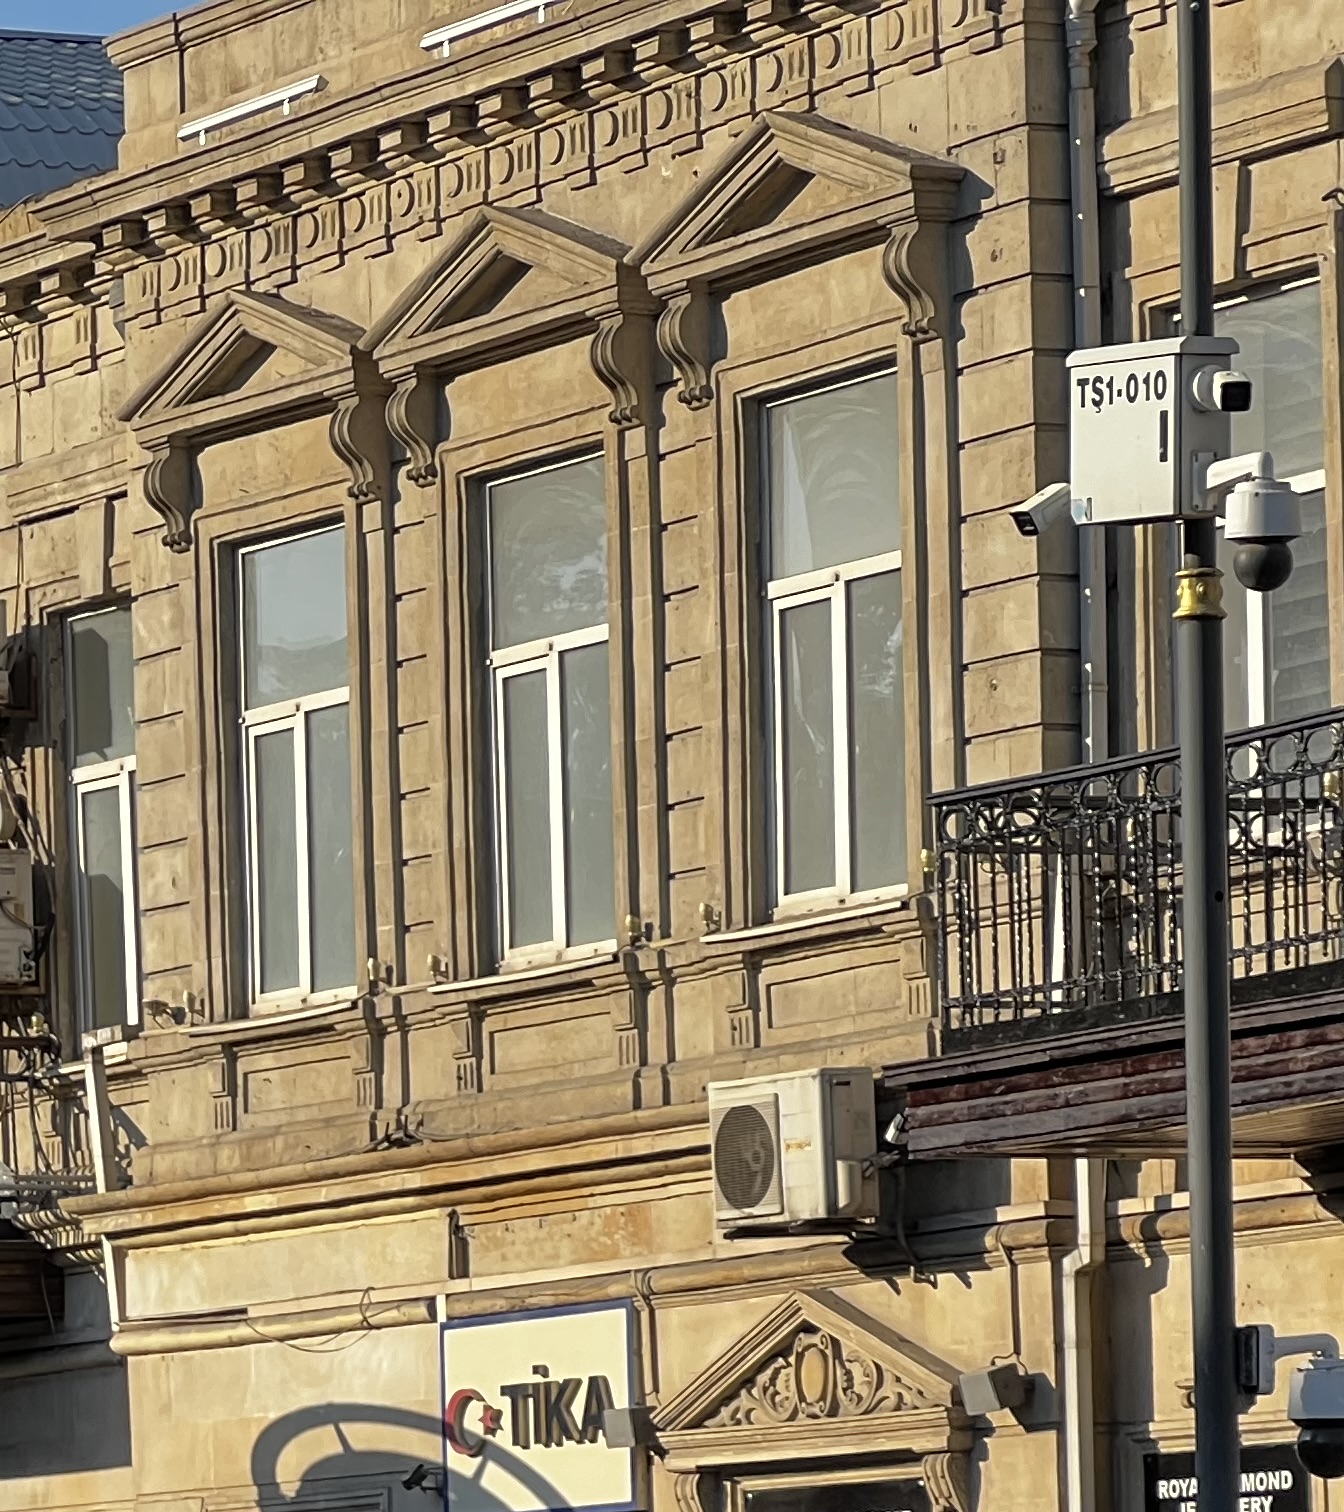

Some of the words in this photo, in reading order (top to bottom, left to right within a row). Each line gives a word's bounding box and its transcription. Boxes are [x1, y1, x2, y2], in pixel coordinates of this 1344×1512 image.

[500, 1364, 616, 1450] TİKA
[1157, 1477, 1199, 1499] ROYA
[1239, 1470, 1294, 1492] MOND
